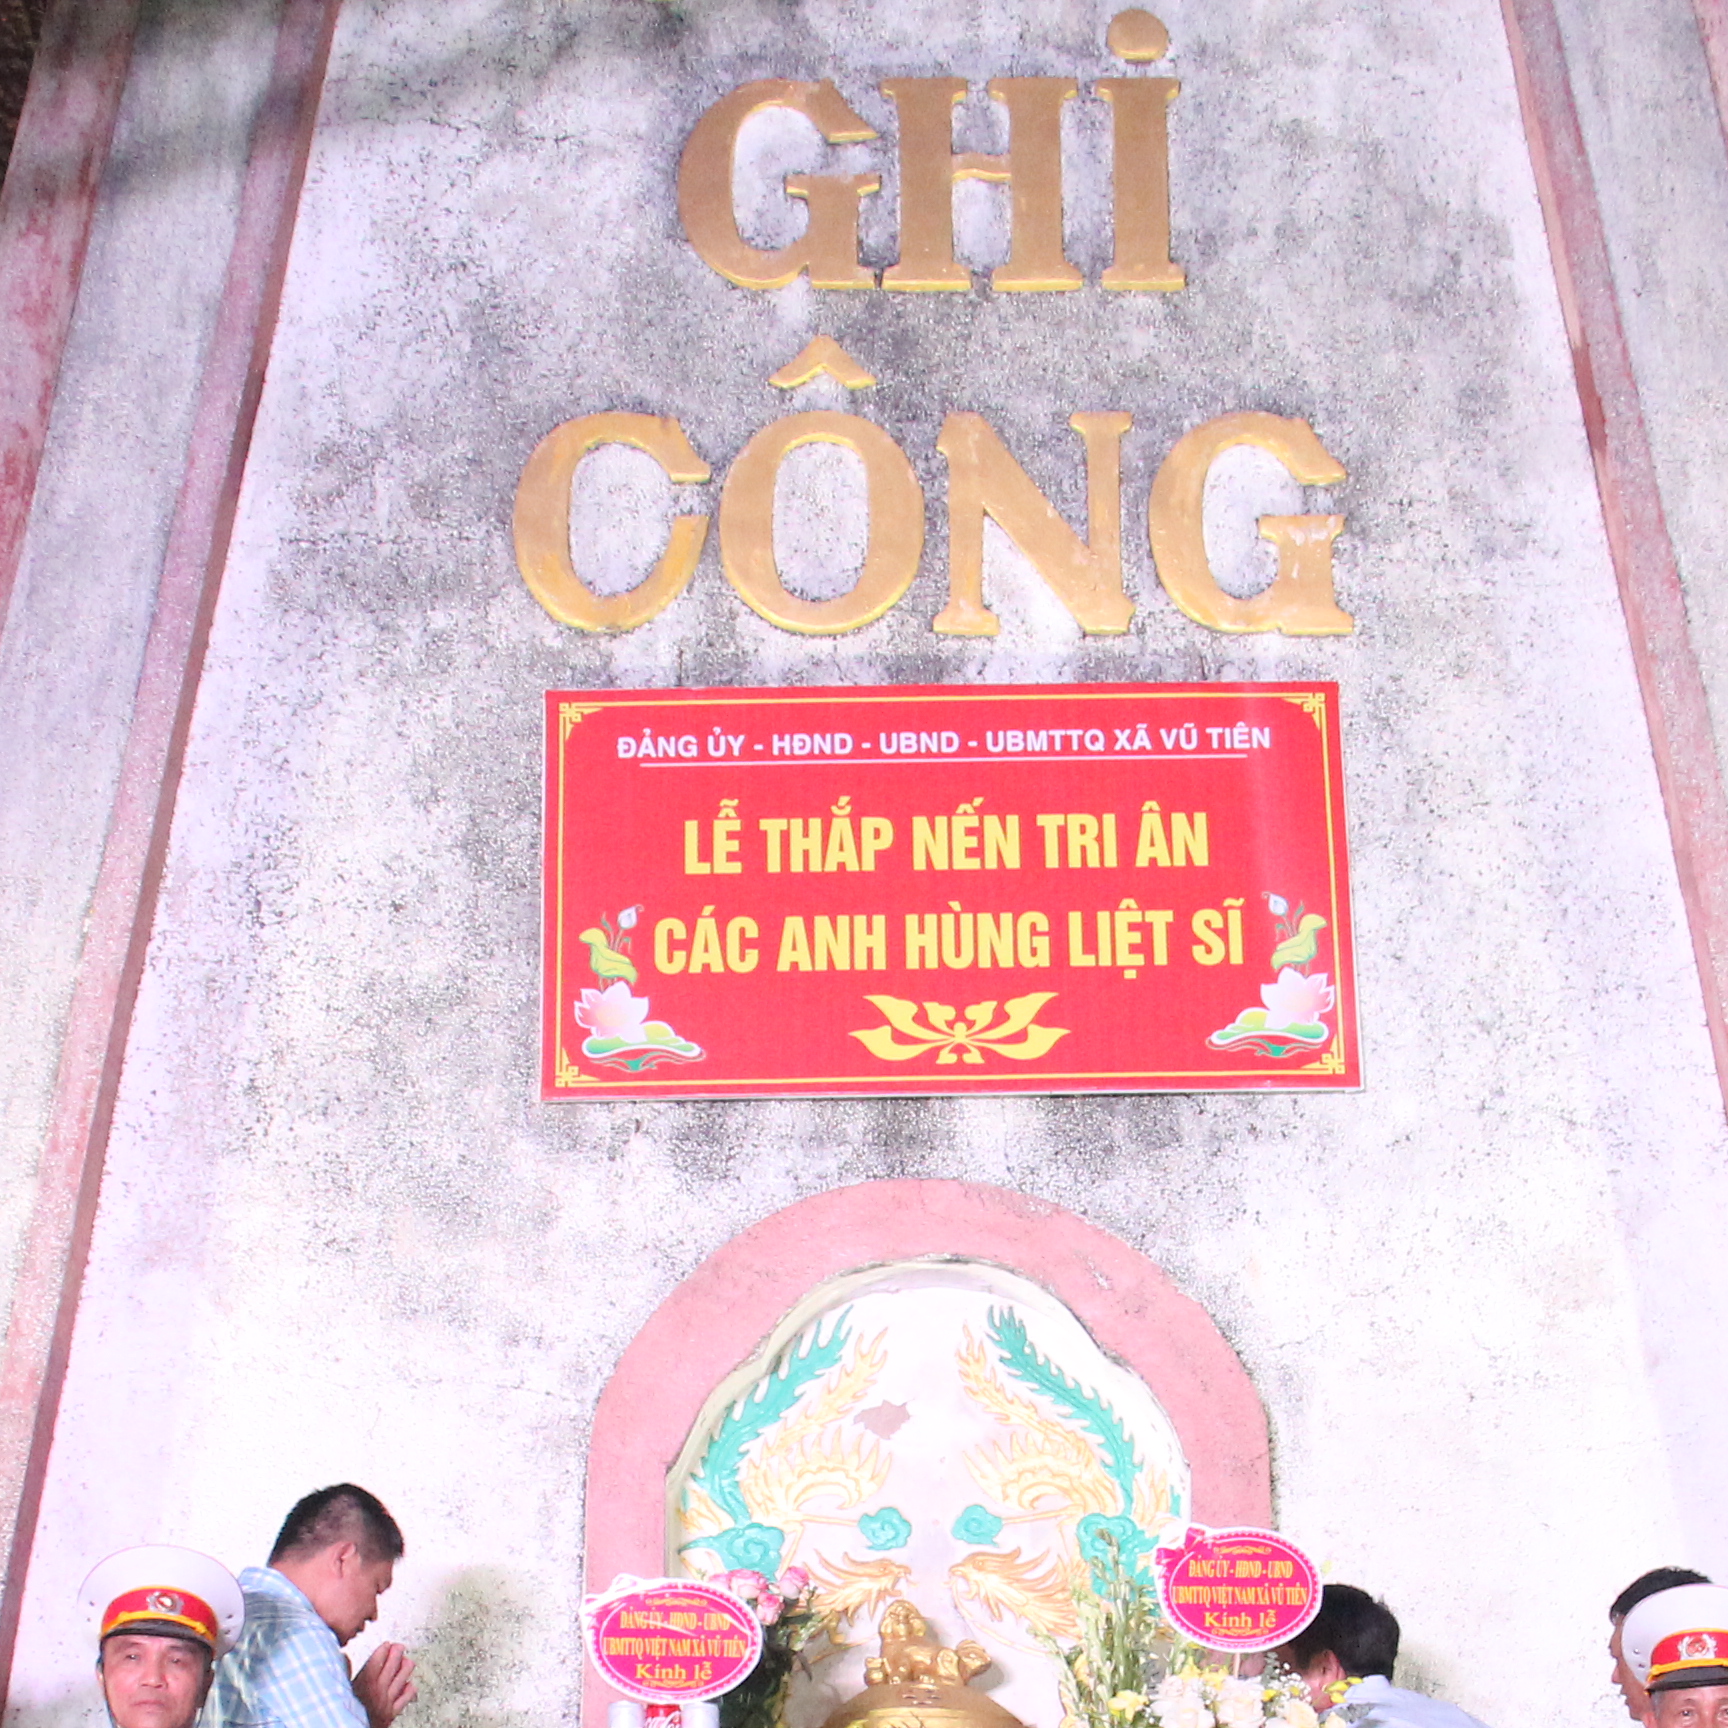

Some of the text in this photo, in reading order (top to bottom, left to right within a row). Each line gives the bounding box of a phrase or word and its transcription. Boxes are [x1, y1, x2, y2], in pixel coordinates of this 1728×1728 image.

[512, 334, 1355, 636] CÔNG
[616, 727, 699, 759] ĐẢNG
[707, 726, 746, 757] ỦY
[771, 732, 854, 756] HĐND
[879, 730, 960, 754] UBND
[985, 728, 1106, 753] UBMTTQ
[1113, 723, 1153, 751] XÃ
[1159, 722, 1199, 750] VŨ
[1205, 720, 1271, 750] TIÊN
[683, 795, 1210, 875] LỄ THẮP NẾN TRI ÂN
[653, 897, 1246, 979] CÁC ANH HÙNG LIỆT SĨ
[1267, 1560, 1293, 1579] UBND
[1234, 1586, 1256, 1605] NAM
[703, 1612, 731, 1630] UBND
[1204, 1609, 1277, 1628] Kính lễ
[669, 1638, 691, 1657] NAM
[635, 1661, 713, 1680] Kính lễ
